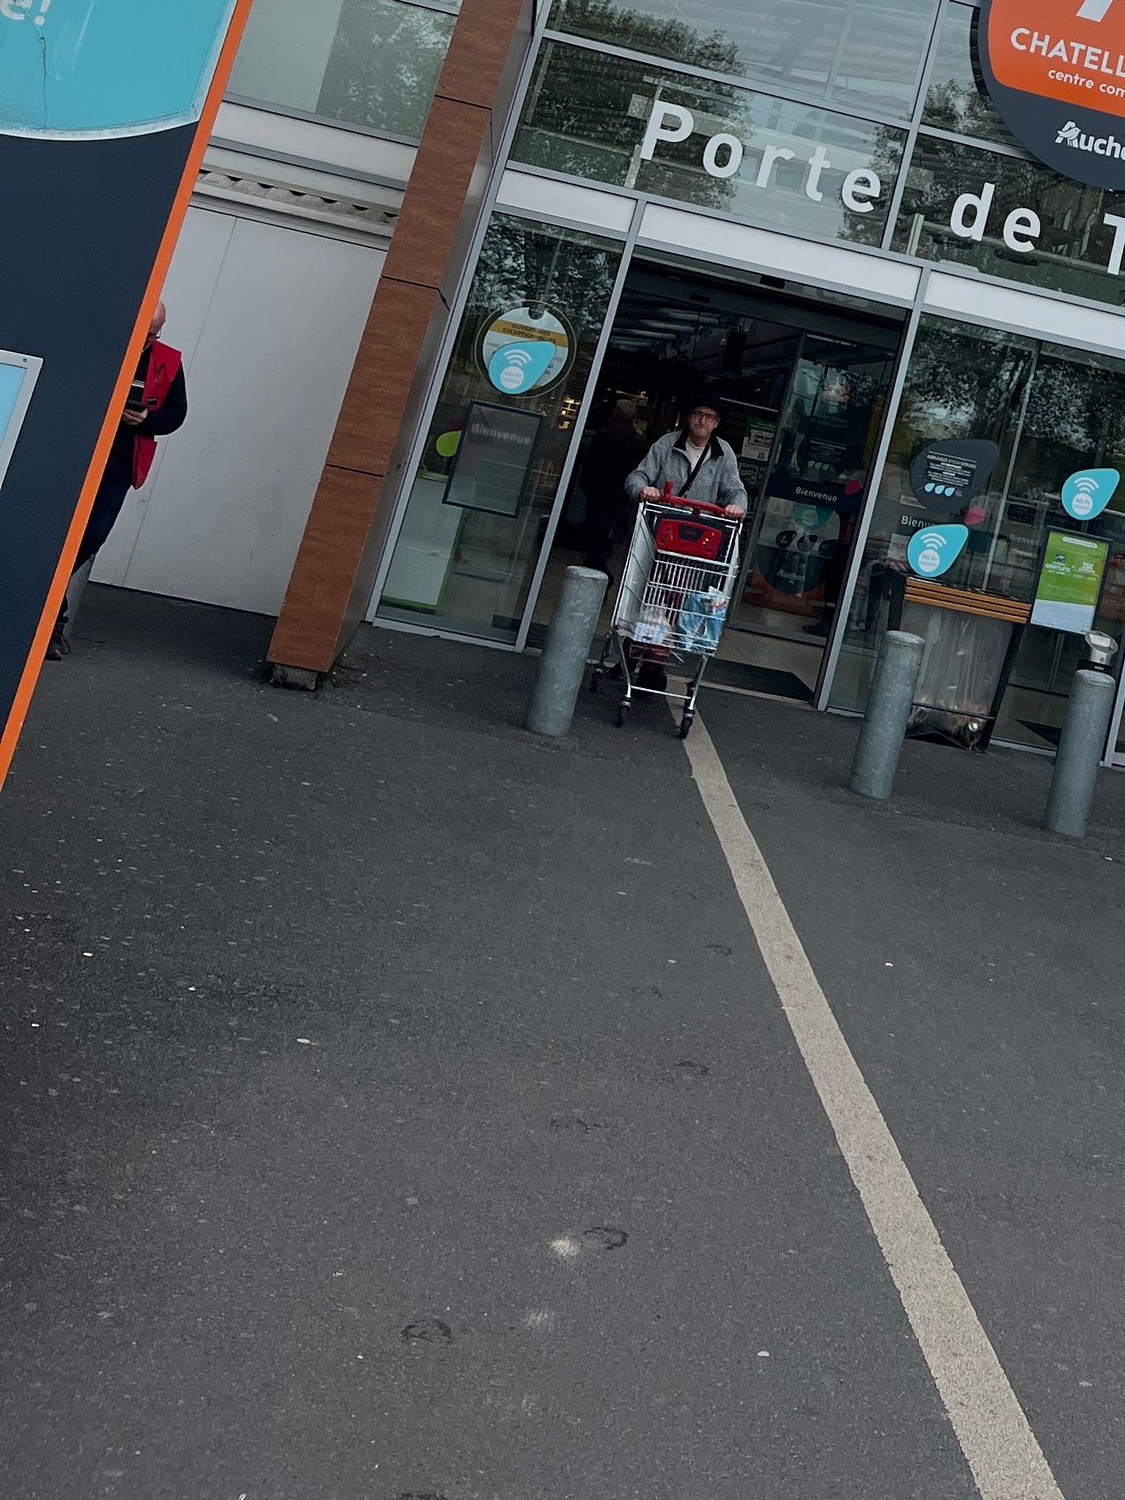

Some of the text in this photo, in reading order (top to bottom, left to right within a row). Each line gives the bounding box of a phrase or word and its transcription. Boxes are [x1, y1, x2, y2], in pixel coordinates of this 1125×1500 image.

[1048, 68, 1095, 89] centre
[640, 99, 882, 213] Porte
[949, 182, 1042, 254] de
[795, 486, 838, 502] Bienvenue
